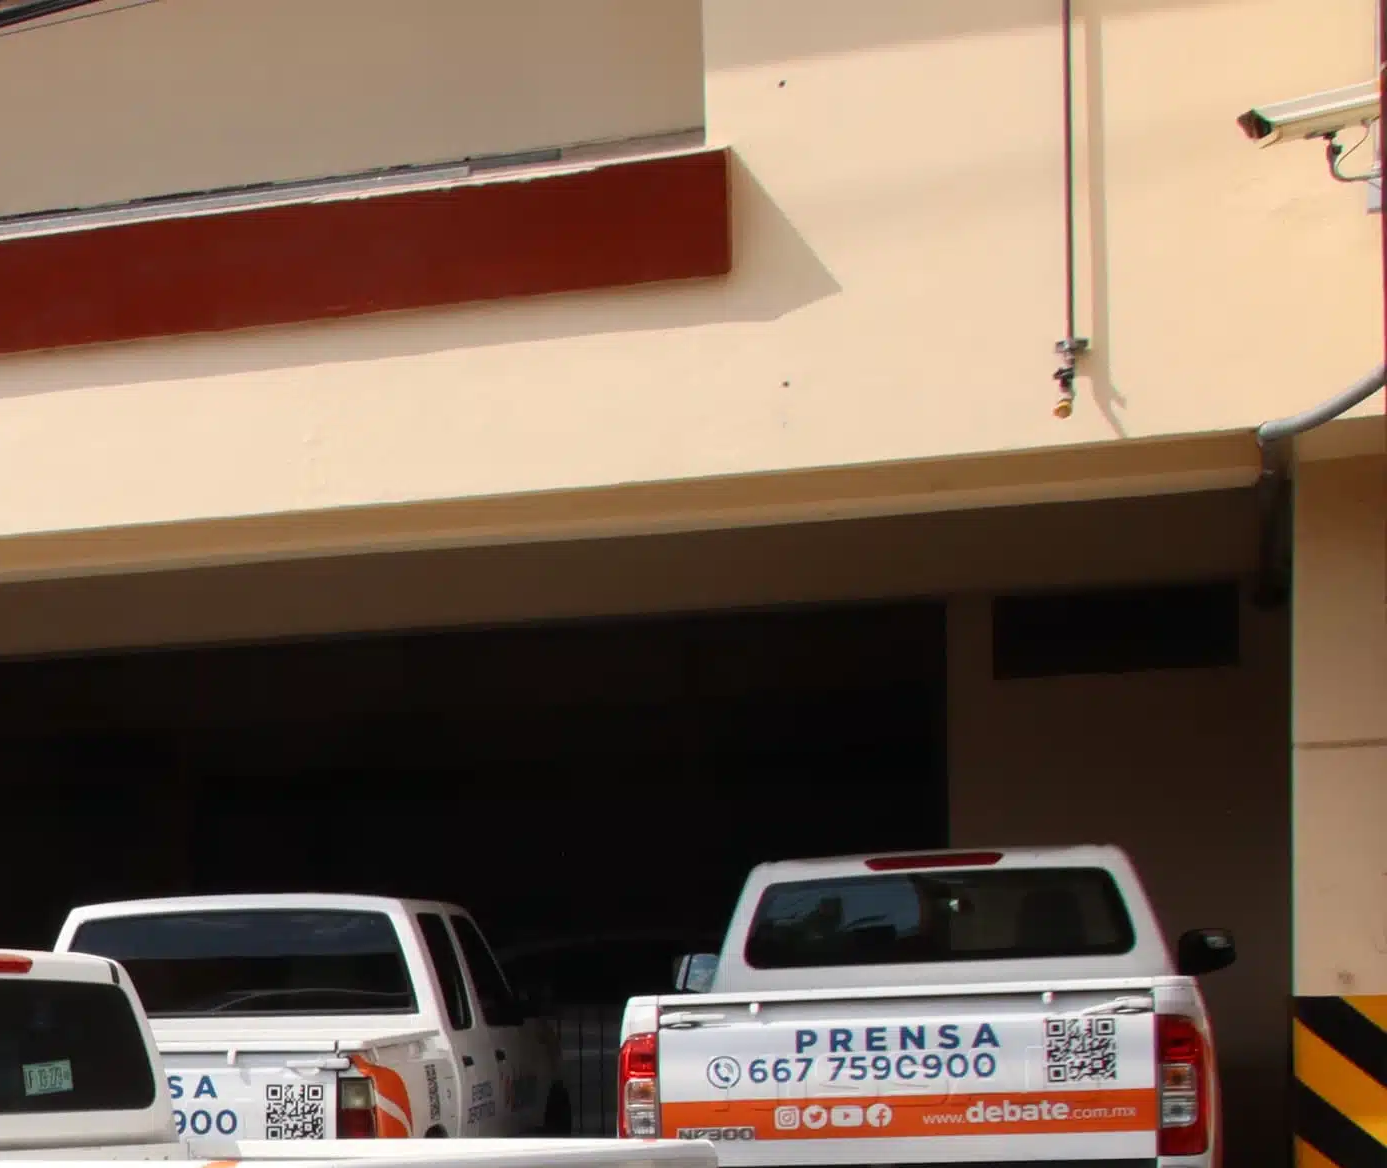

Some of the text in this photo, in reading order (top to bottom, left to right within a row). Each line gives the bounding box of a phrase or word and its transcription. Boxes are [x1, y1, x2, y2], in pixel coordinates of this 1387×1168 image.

[795, 1023, 1000, 1053] PRENSA
[748, 1058, 813, 1083] 667
[922, 1100, 1137, 1124] www.debate.com.mx
